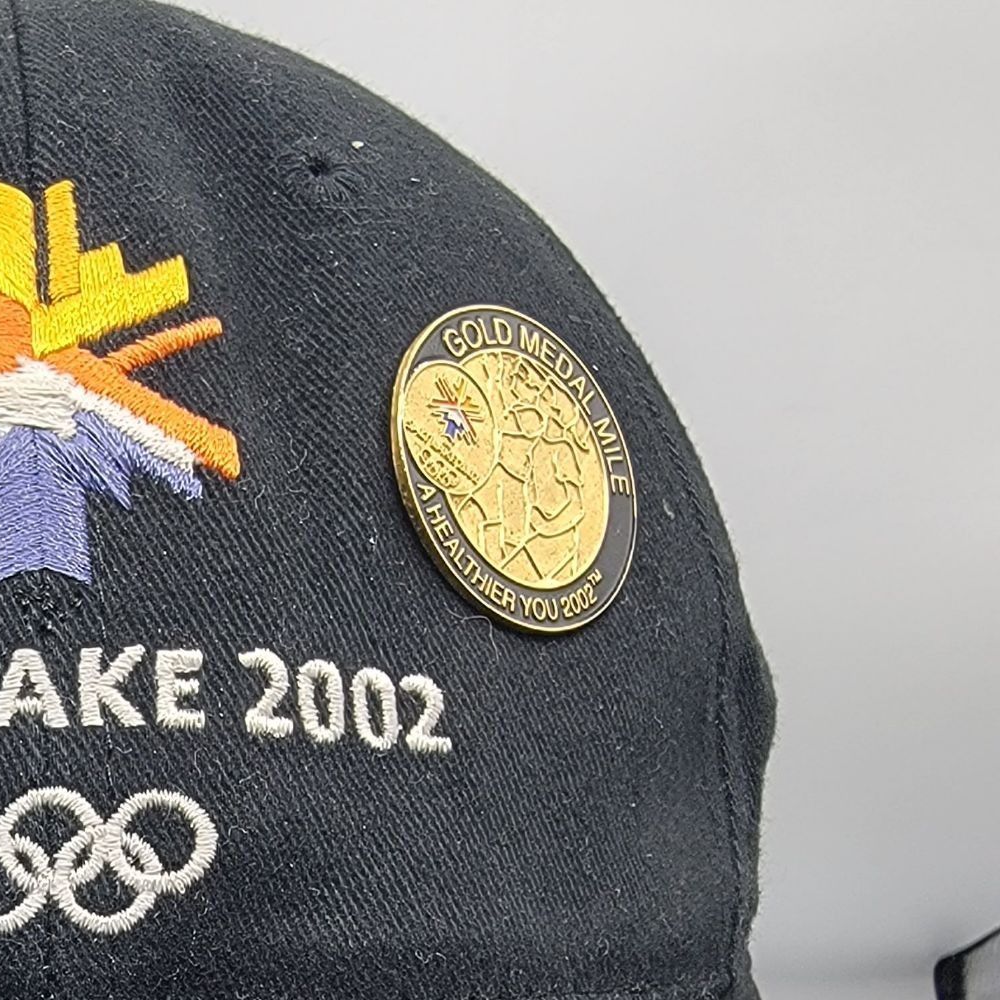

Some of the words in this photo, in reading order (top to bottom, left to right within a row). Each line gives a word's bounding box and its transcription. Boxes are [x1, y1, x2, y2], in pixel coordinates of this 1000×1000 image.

[442, 317, 512, 358] GOLD
[519, 324, 595, 416] MEDAL
[592, 416, 631, 497] MILE
[416, 482, 436, 501] A
[424, 502, 517, 612] HEALTHIER
[519, 596, 559, 622] YOU
[238, 648, 453, 753] 2002
